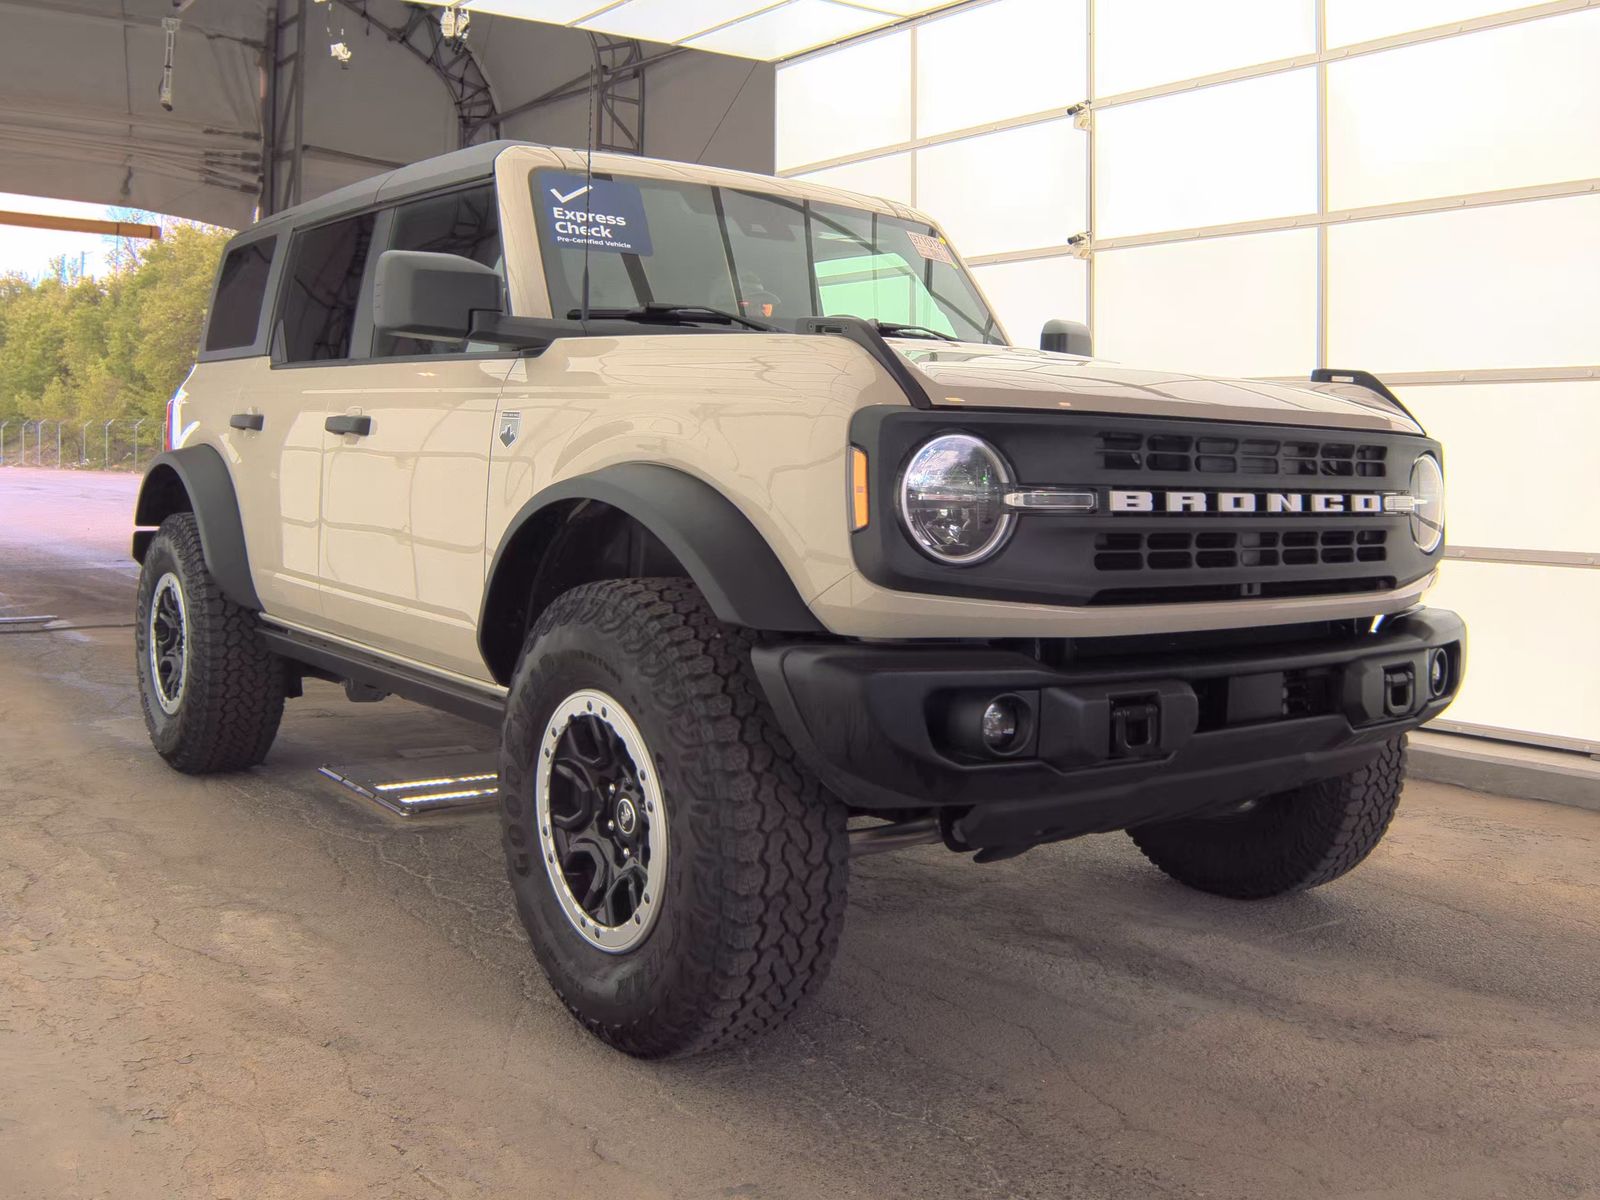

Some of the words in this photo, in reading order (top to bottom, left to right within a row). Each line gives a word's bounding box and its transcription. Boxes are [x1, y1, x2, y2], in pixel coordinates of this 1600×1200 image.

[552, 206, 627, 226] Express
[555, 221, 613, 238] Check
[604, 240, 632, 249] Vehicle
[1109, 490, 1381, 513] BRONCO
